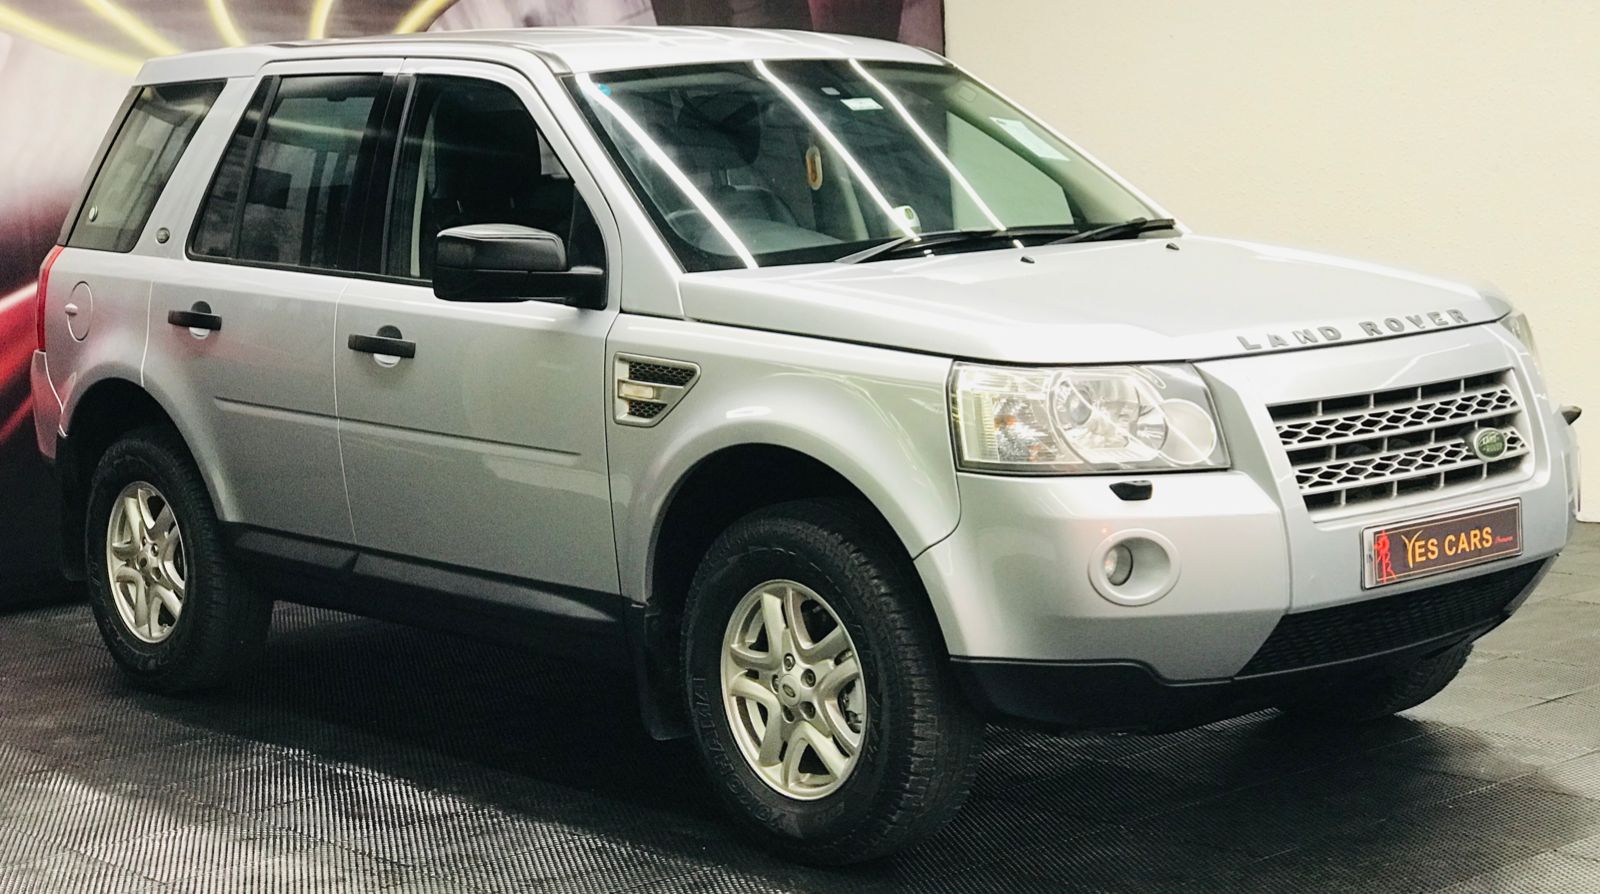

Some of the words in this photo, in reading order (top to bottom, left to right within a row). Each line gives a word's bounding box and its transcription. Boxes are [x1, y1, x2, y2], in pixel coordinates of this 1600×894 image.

[1236, 325, 1342, 351] LAND
[1358, 308, 1469, 337] ROVER
[1401, 529, 1439, 569] YES
[1444, 526, 1493, 557] CARS
